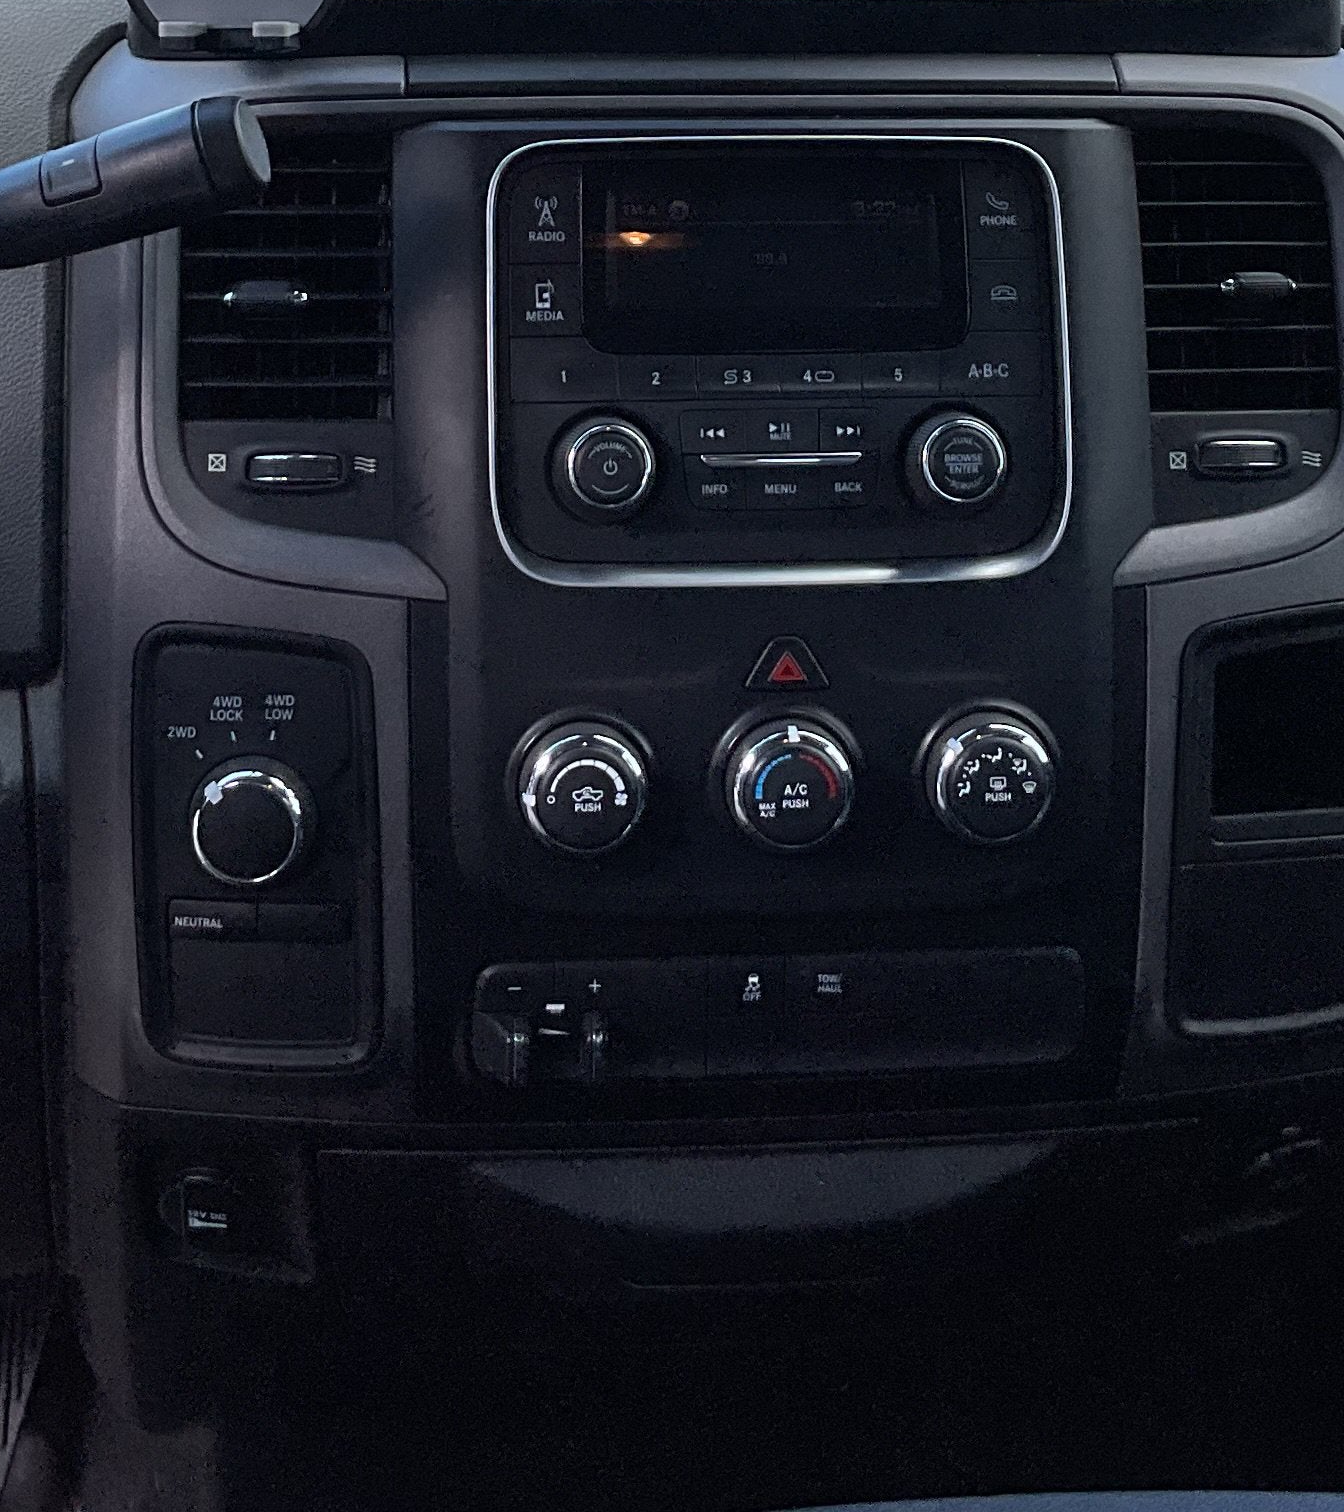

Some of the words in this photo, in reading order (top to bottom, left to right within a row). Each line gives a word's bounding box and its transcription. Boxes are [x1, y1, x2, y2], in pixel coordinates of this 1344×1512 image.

[980, 215, 1017, 226] PHONE
[528, 231, 565, 242] RADIO
[526, 310, 564, 322] MEDIA
[560, 370, 567, 384] 1
[651, 371, 661, 385] 2
[742, 369, 752, 383] 3
[803, 369, 812, 383] 4
[894, 368, 903, 382] 5
[769, 432, 792, 441] MUTE
[593, 441, 626, 453] VOLUME
[944, 453, 983, 463] BROWSE
[949, 464, 980, 475] ENTER
[701, 483, 728, 496] INFO
[764, 483, 797, 495] MENU
[834, 481, 863, 493] BACK
[213, 696, 242, 708] 4WD
[265, 694, 295, 707] 4WD
[210, 709, 243, 721] LOCK
[265, 709, 293, 720] LOW
[167, 726, 196, 738] 2WD
[784, 783, 808, 797] A/C
[985, 791, 1012, 803] PUSH
[574, 802, 602, 813] PUSH
[759, 802, 777, 810] MAX
[782, 799, 810, 809] PUSH
[759, 810, 776, 818] A/C
[174, 915, 224, 929] NEUTRAL
[742, 991, 762, 1002] OFF
